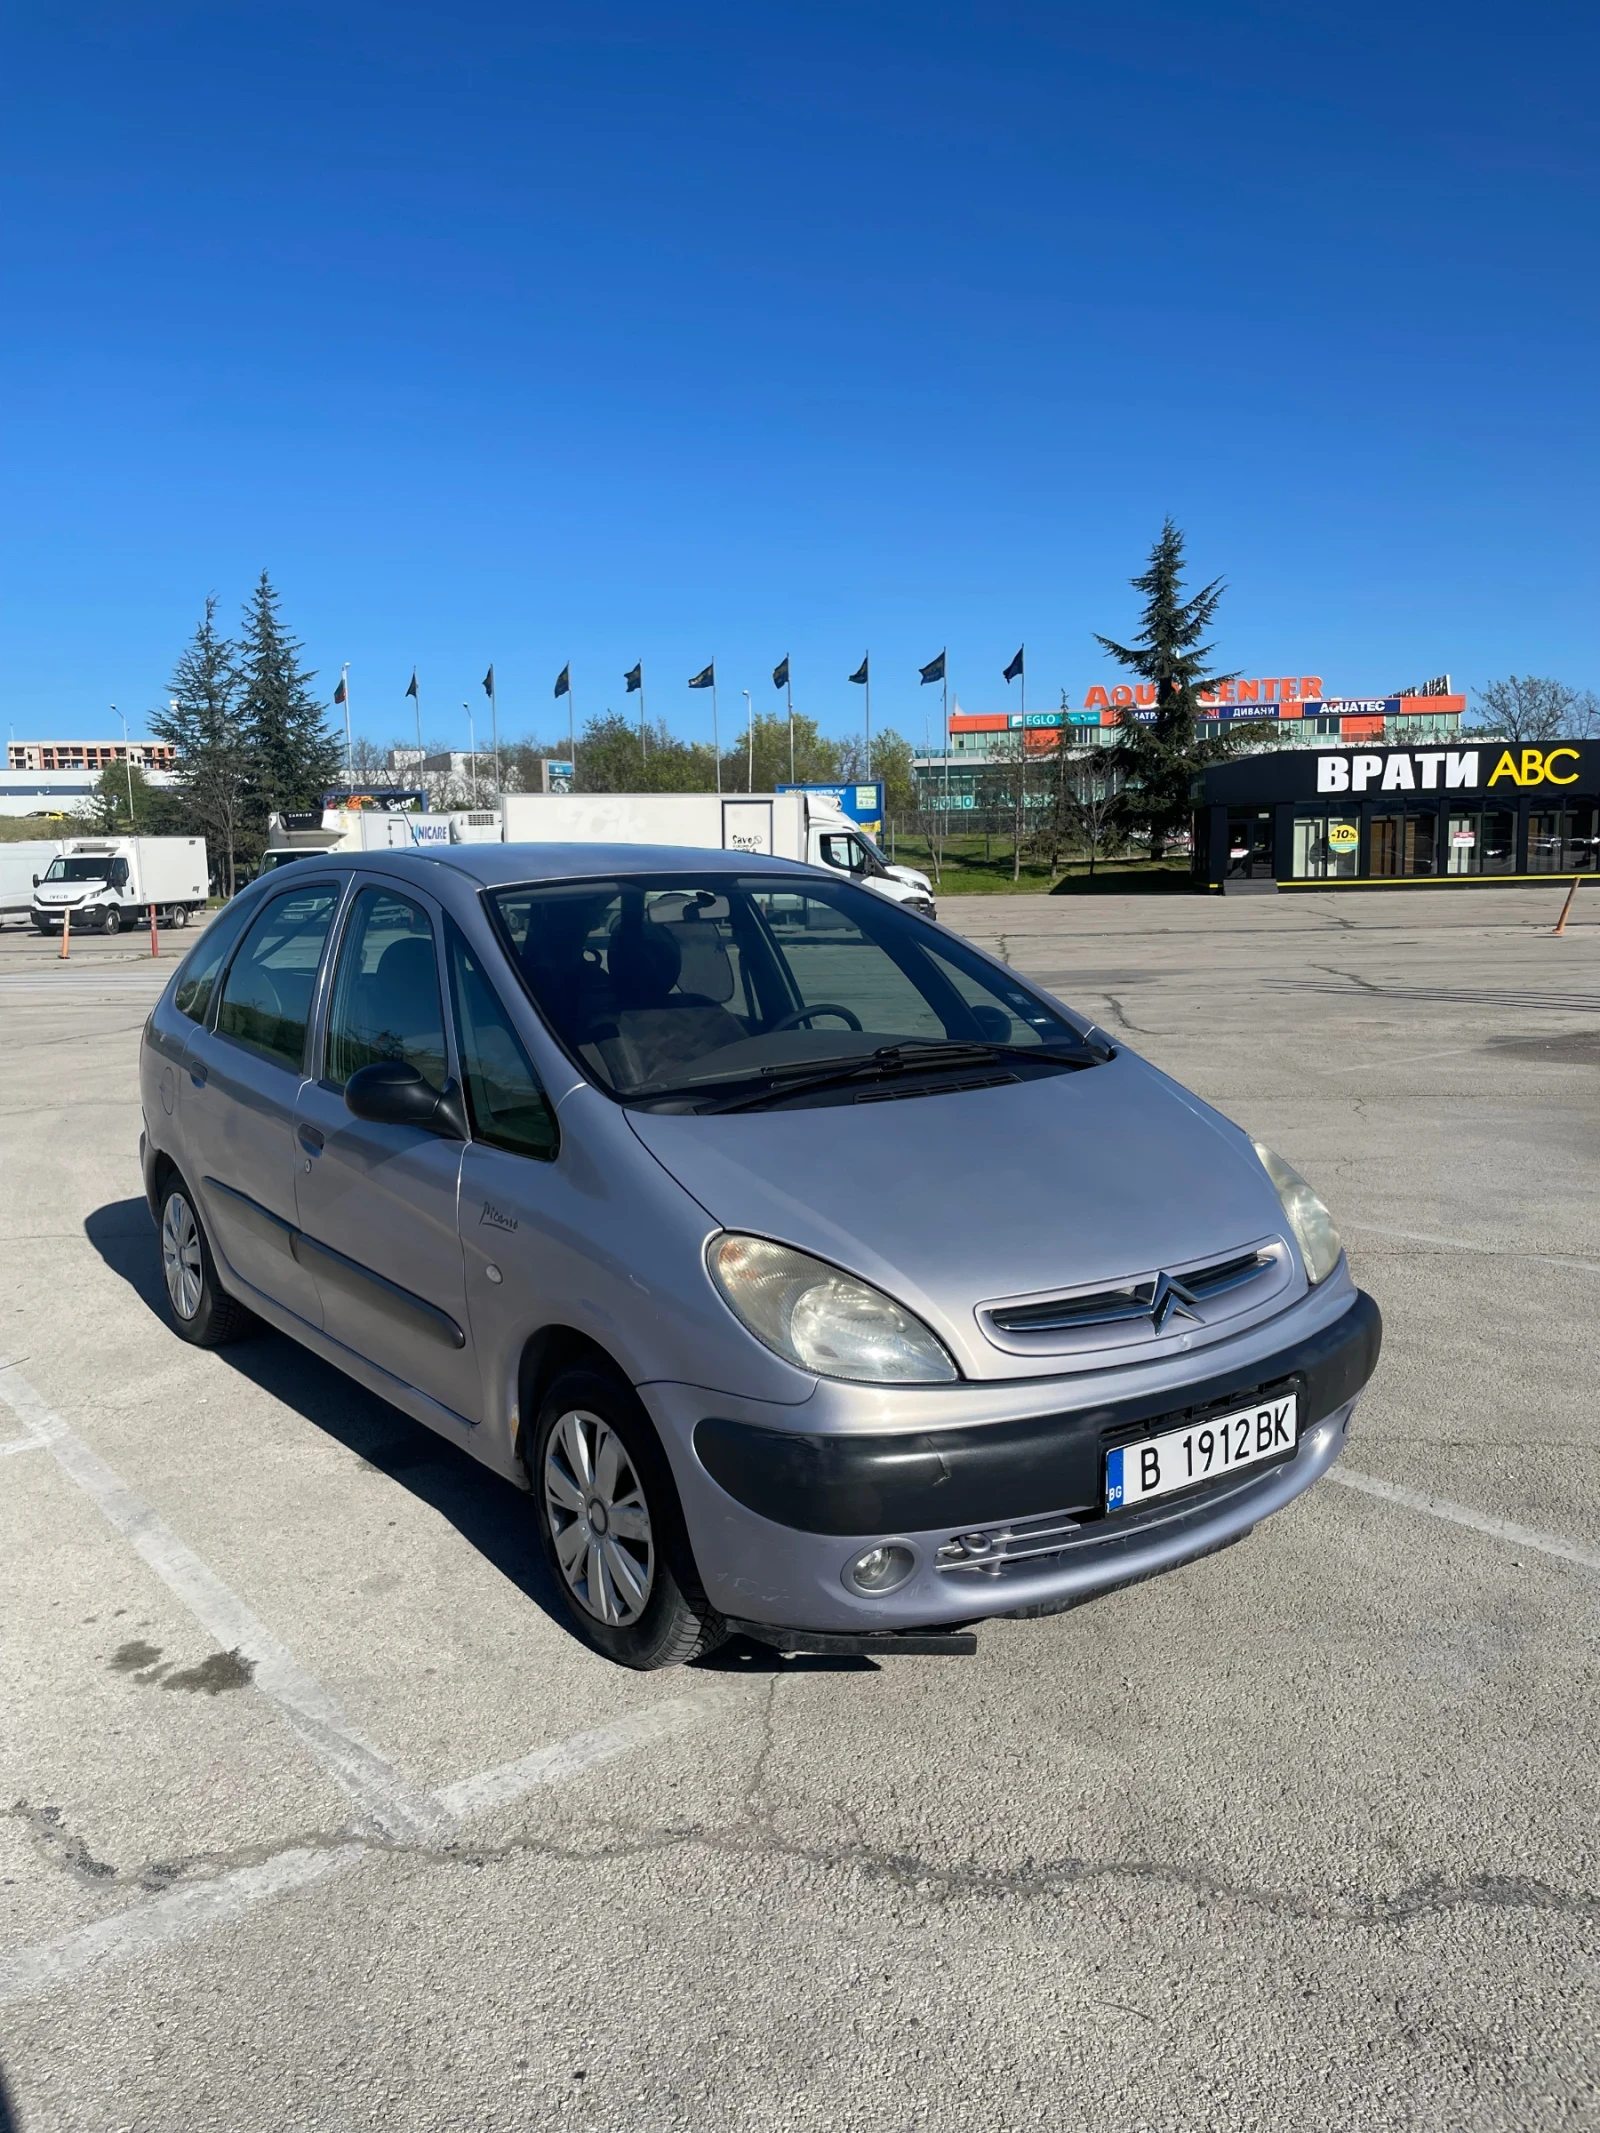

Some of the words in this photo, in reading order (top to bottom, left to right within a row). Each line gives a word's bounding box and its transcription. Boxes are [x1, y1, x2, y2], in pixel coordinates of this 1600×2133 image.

[1084, 683, 1181, 707] AQU
[1233, 706, 1275, 717] ДИВАНИ
[1319, 700, 1386, 713] AQUATEC
[1026, 714, 1056, 725] EGLO
[1317, 751, 1479, 792] ВРАТИ
[1486, 748, 1581, 787] ABC
[1331, 829, 1357, 839] -10%
[1141, 1446, 1161, 1492] B
[1108, 1486, 1122, 1501] BG
